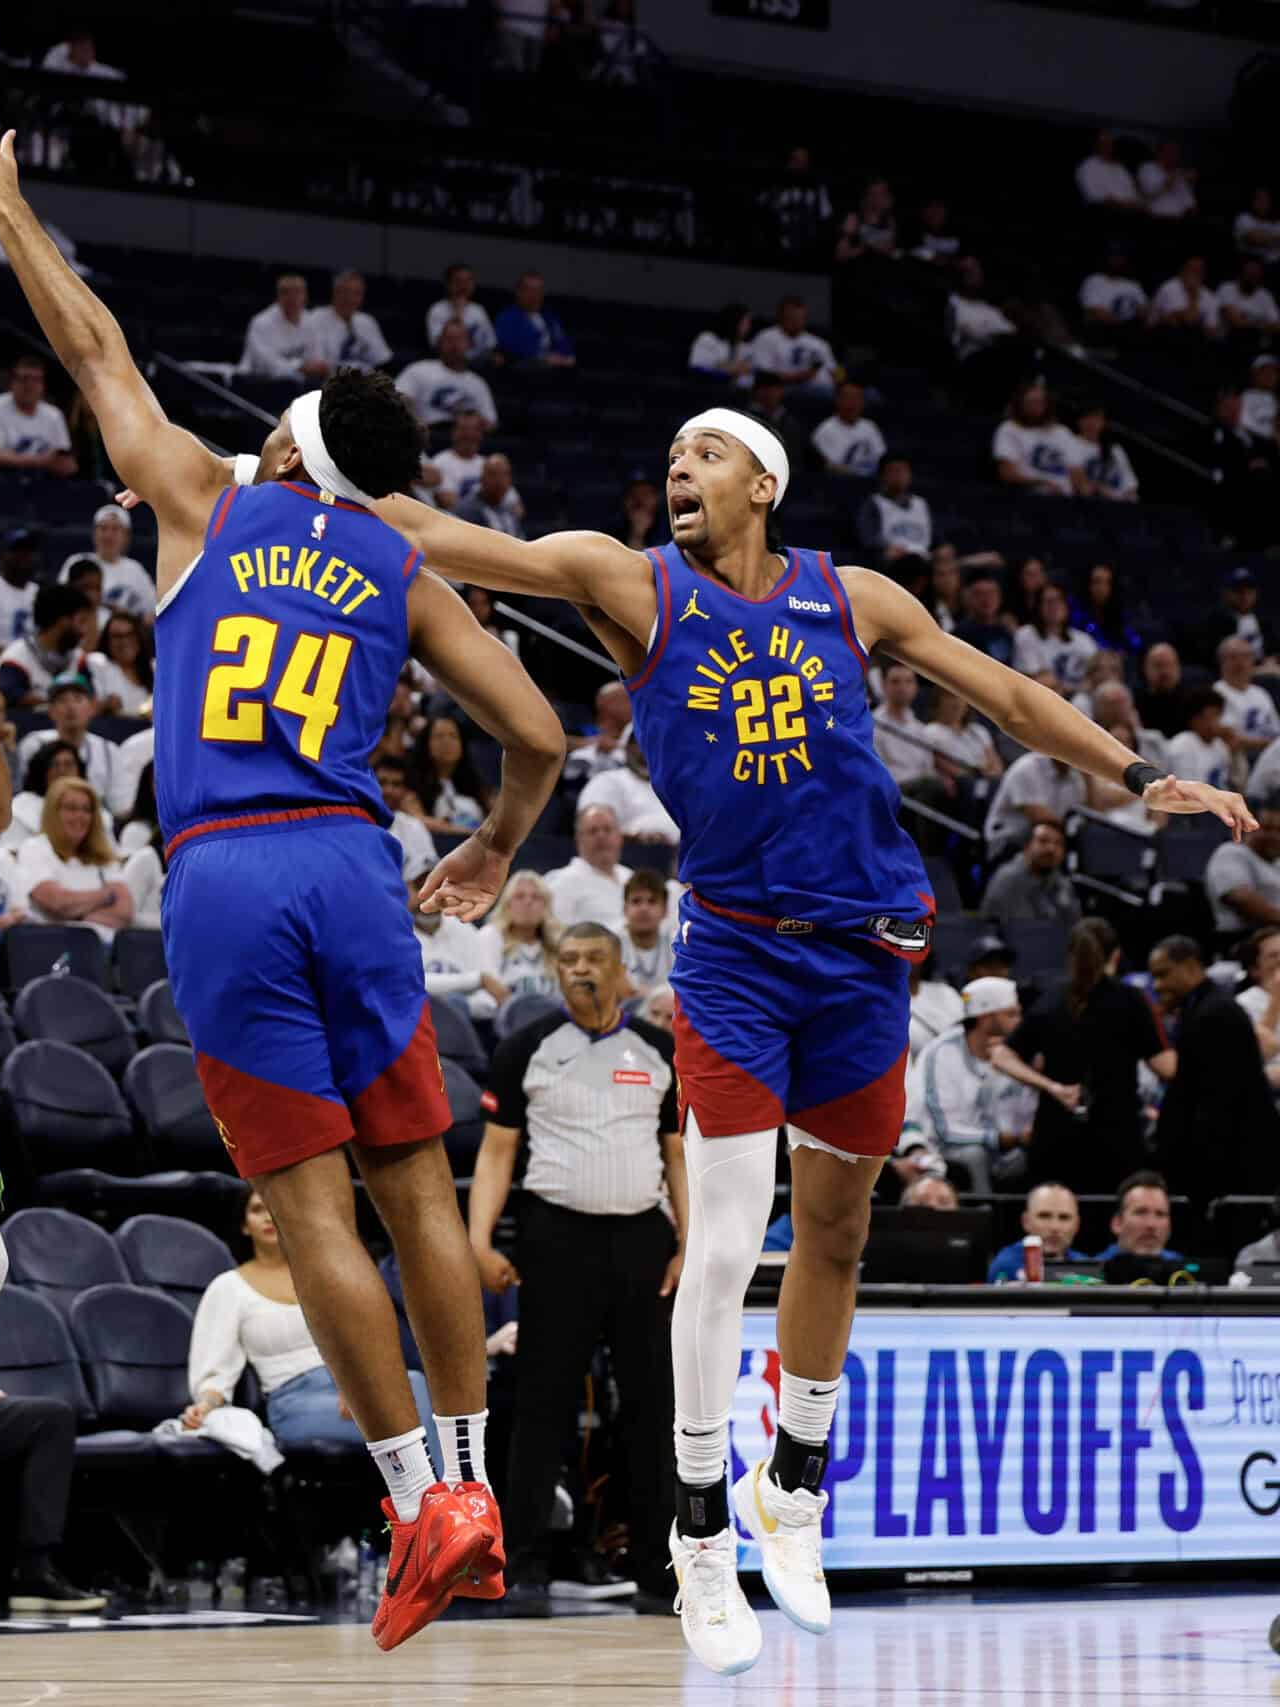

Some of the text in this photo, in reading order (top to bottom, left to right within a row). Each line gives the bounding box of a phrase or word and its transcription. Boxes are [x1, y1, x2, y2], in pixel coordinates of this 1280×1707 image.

[229, 545, 381, 616] PICKETT
[788, 596, 832, 613] ibotta
[201, 613, 356, 764] 24
[687, 625, 835, 711] MILE HIGH
[731, 674, 808, 746] 22
[733, 742, 814, 785] CITY
[1231, 1359, 1280, 1426] Pre
[822, 1348, 1205, 1539] PLAYOFFS
